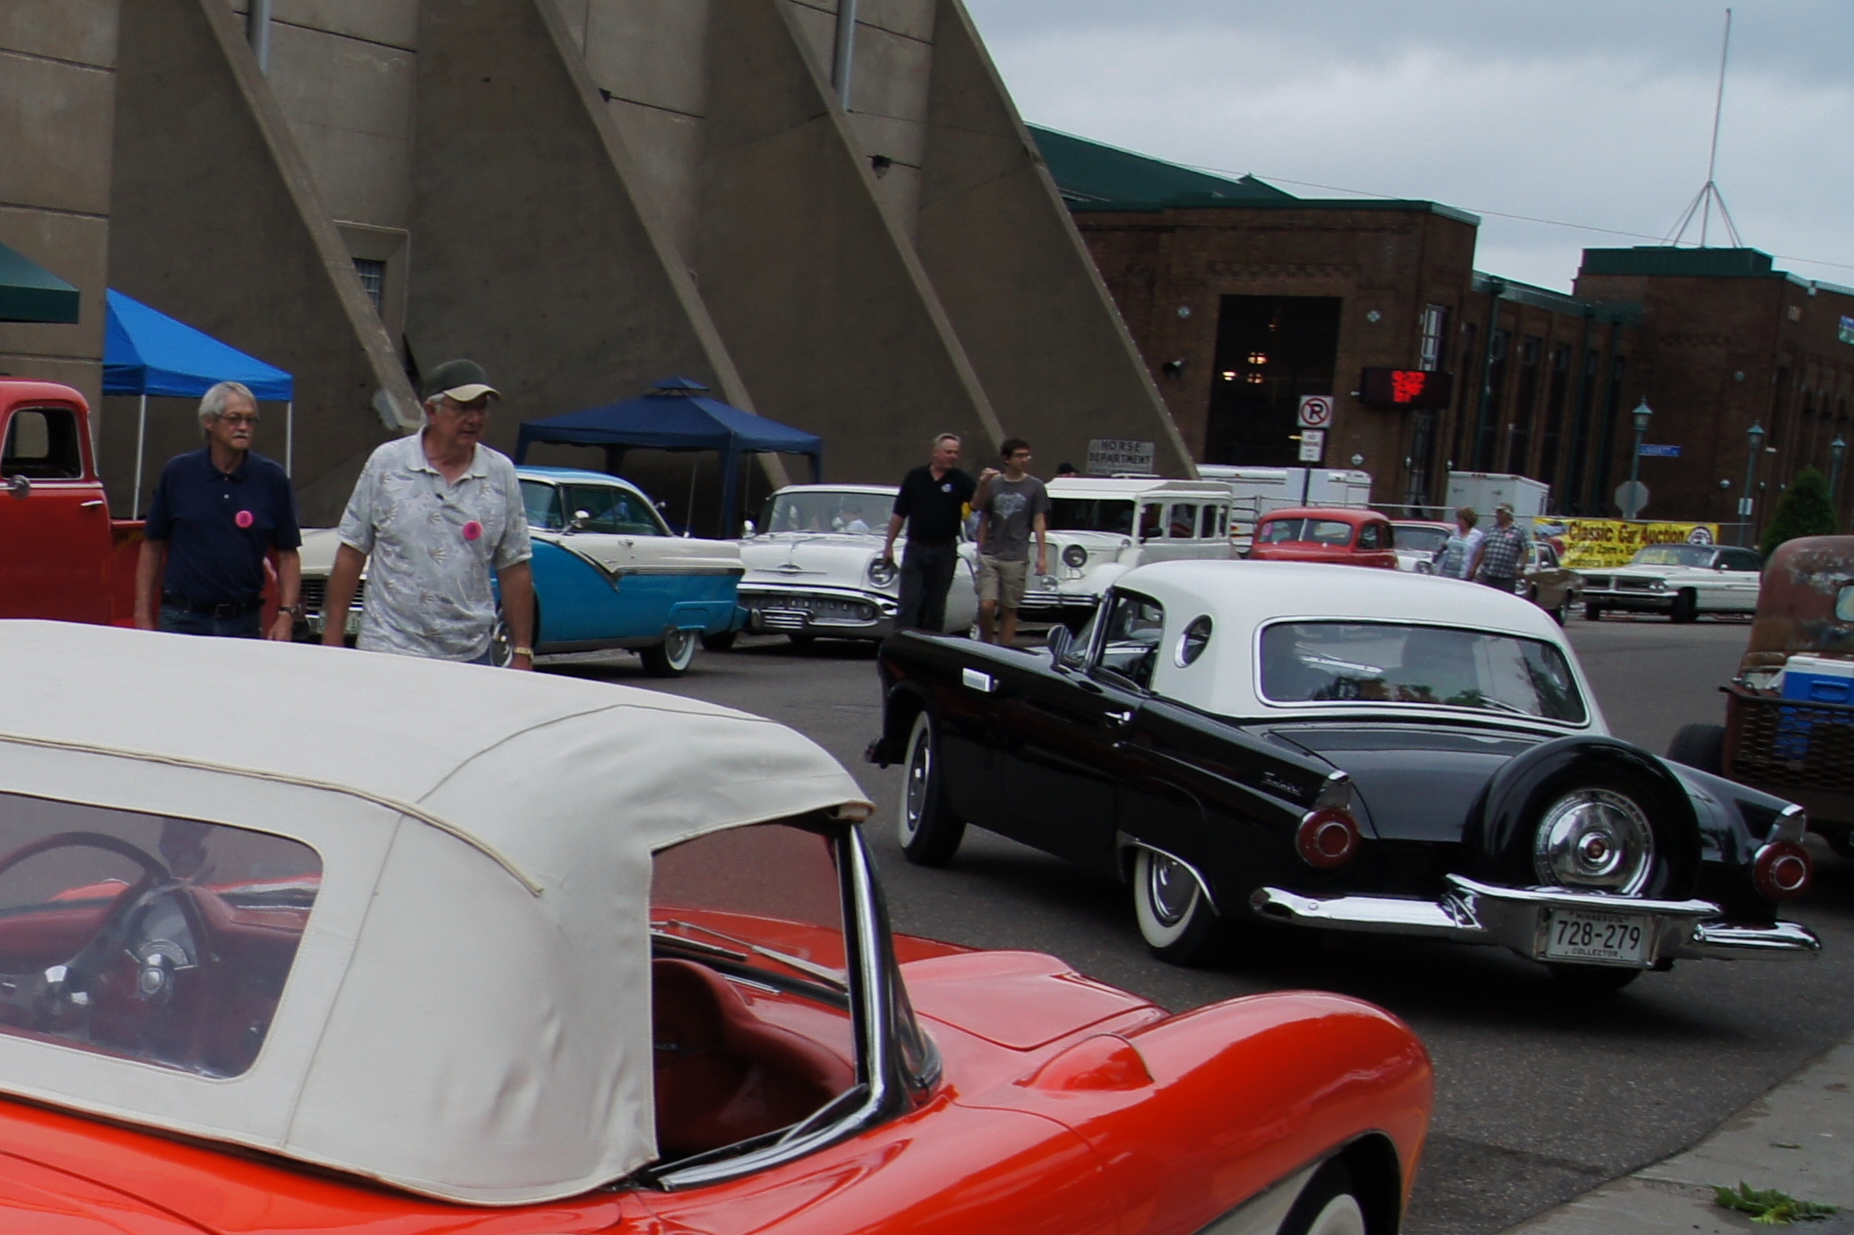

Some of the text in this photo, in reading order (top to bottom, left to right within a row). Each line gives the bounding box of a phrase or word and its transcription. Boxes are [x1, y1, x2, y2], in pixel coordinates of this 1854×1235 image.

[1101, 441, 1141, 452] HORSE
[1088, 452, 1151, 464] DEPARTMENT
[1568, 521, 1686, 545] Classic Car Auction
[1557, 919, 1641, 951] 728-279
[1572, 947, 1618, 958] COLLECTOR
